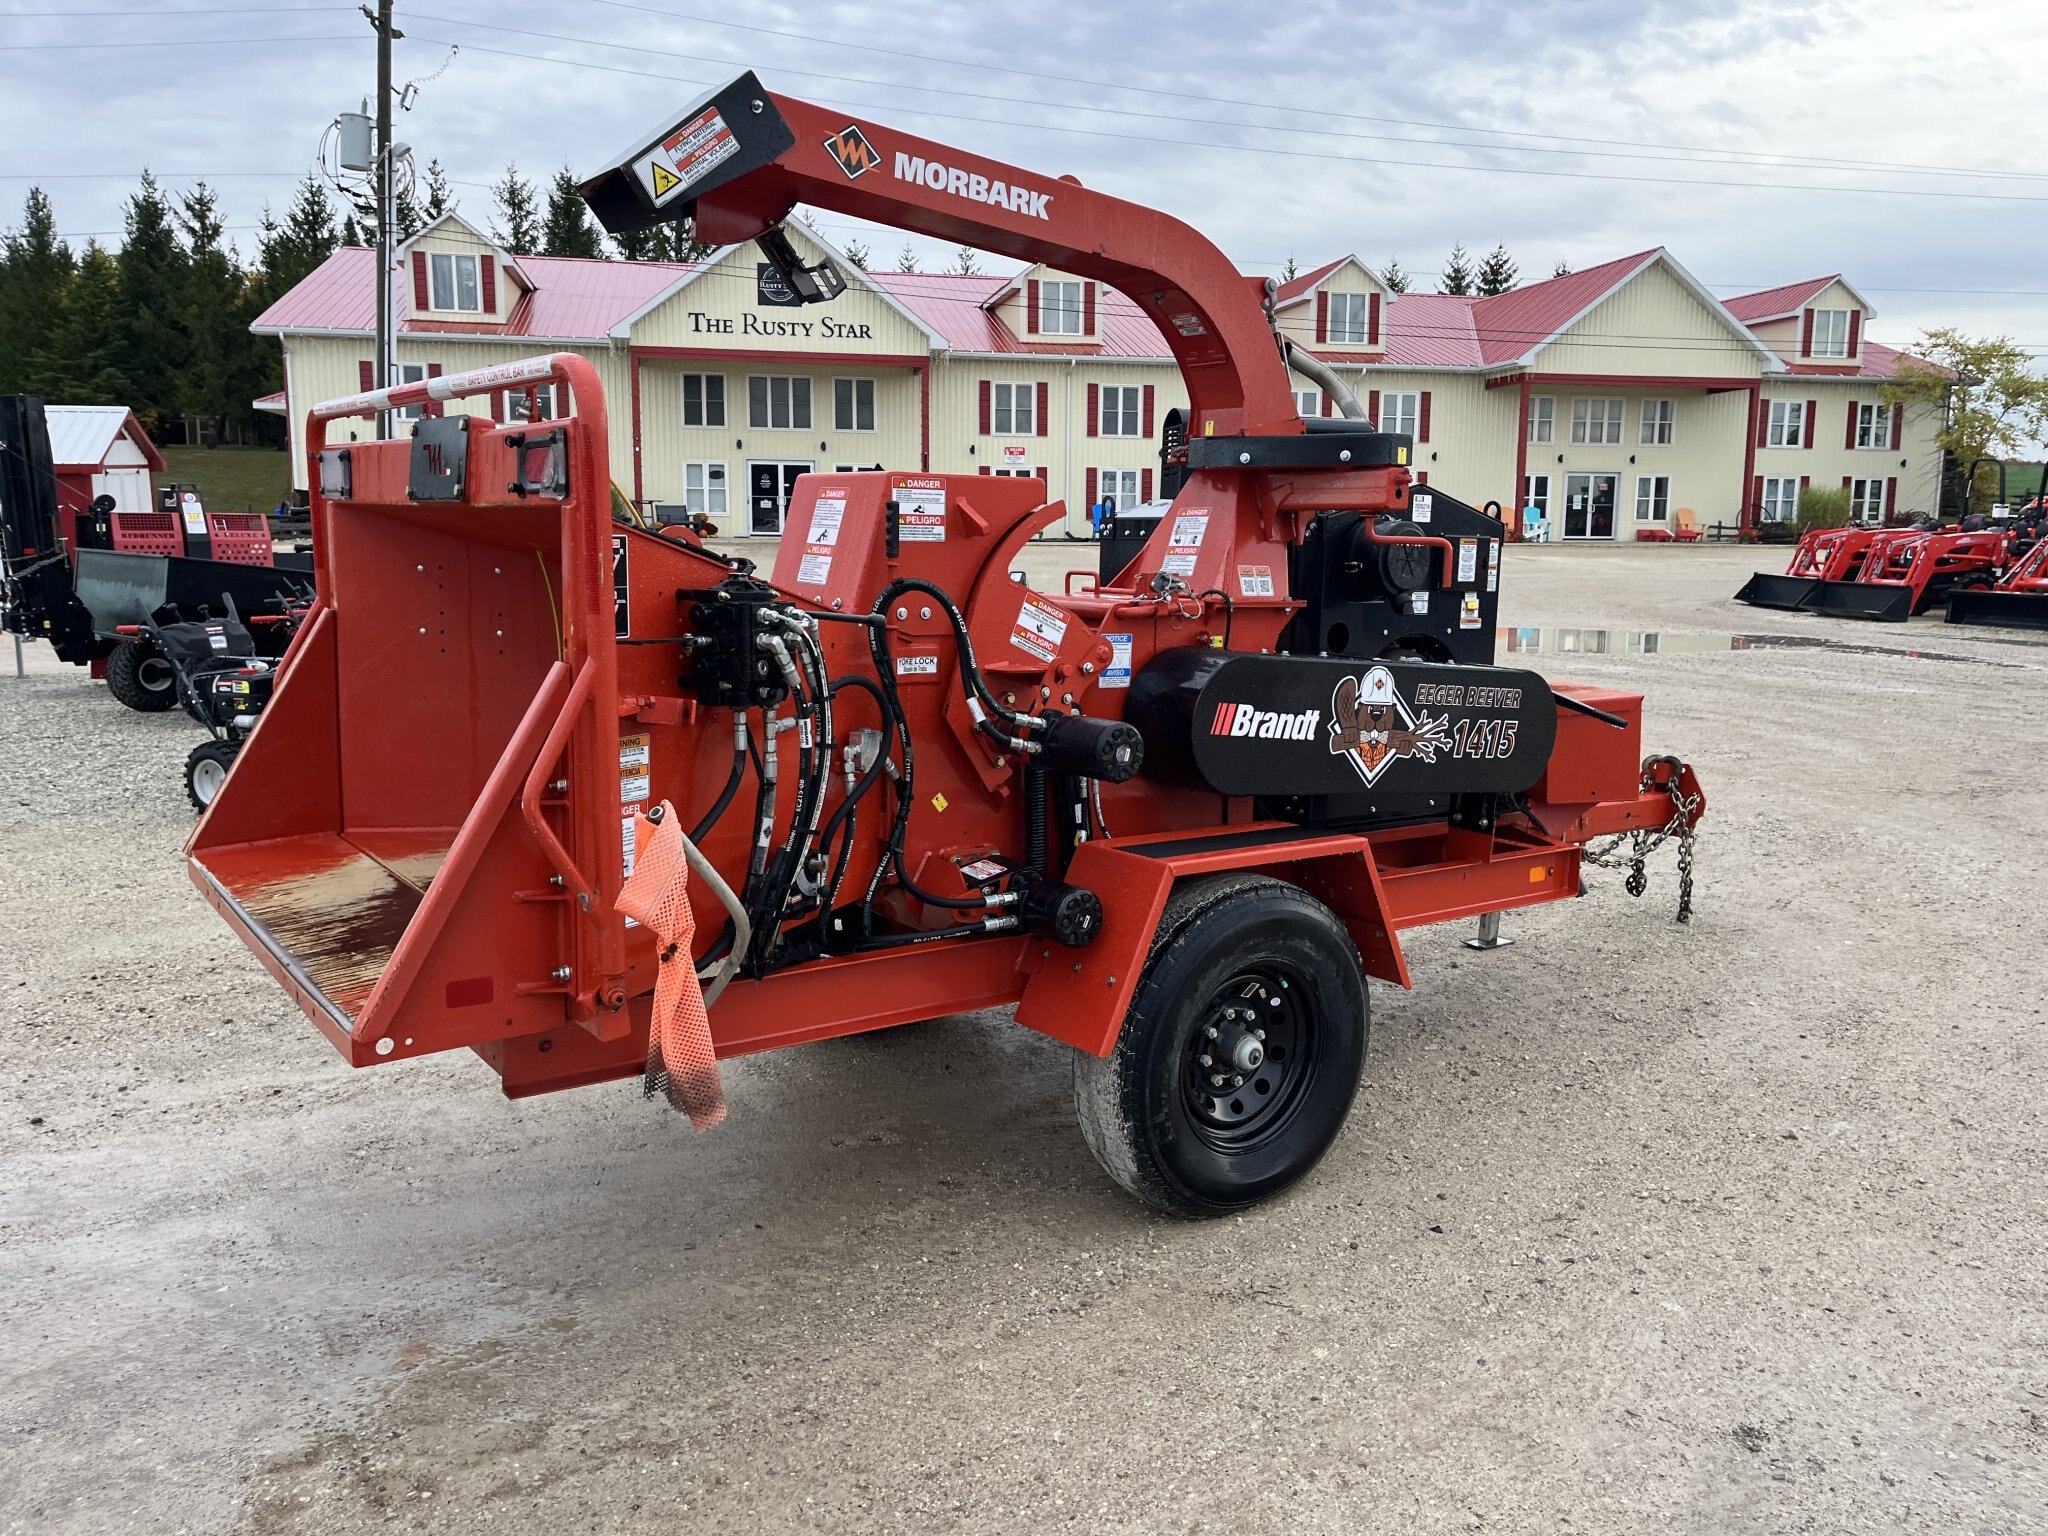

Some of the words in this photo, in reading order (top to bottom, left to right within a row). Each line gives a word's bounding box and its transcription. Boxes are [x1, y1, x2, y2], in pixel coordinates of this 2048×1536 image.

[673, 137, 692, 153] FLYING
[692, 120, 717, 141] MATERIAL
[682, 118, 705, 137] DANGER
[683, 156, 709, 176] MATERIAL
[708, 137, 733, 157] VOLANDO
[694, 138, 718, 158] PELIGRO
[894, 151, 1050, 221] MORBARK
[759, 280, 782, 289] RUSTY
[688, 312, 734, 334] THE
[741, 313, 814, 337] RUSTY
[821, 316, 873, 339] STAR
[467, 375, 486, 386] SAFETY
[486, 369, 513, 383] CONTROL
[512, 366, 526, 378] BAR
[907, 480, 941, 489] DANGER
[906, 516, 941, 525] PELIGRO
[811, 546, 832, 554] PELIGRO
[1038, 601, 1064, 620] DANGER
[1026, 631, 1053, 651] PELIGRO
[899, 658, 914, 666] YOKE
[914, 657, 935, 665] LOCK
[1414, 684, 1463, 706] EEGER
[1465, 685, 1522, 708] BEEVER
[1230, 703, 1321, 741] Brandt
[1453, 719, 1519, 758] 1415
[621, 767, 641, 777] TENCIA
[796, 779, 804, 812] EC215-08
[621, 803, 641, 816] GER
[786, 829, 797, 852] Winner
